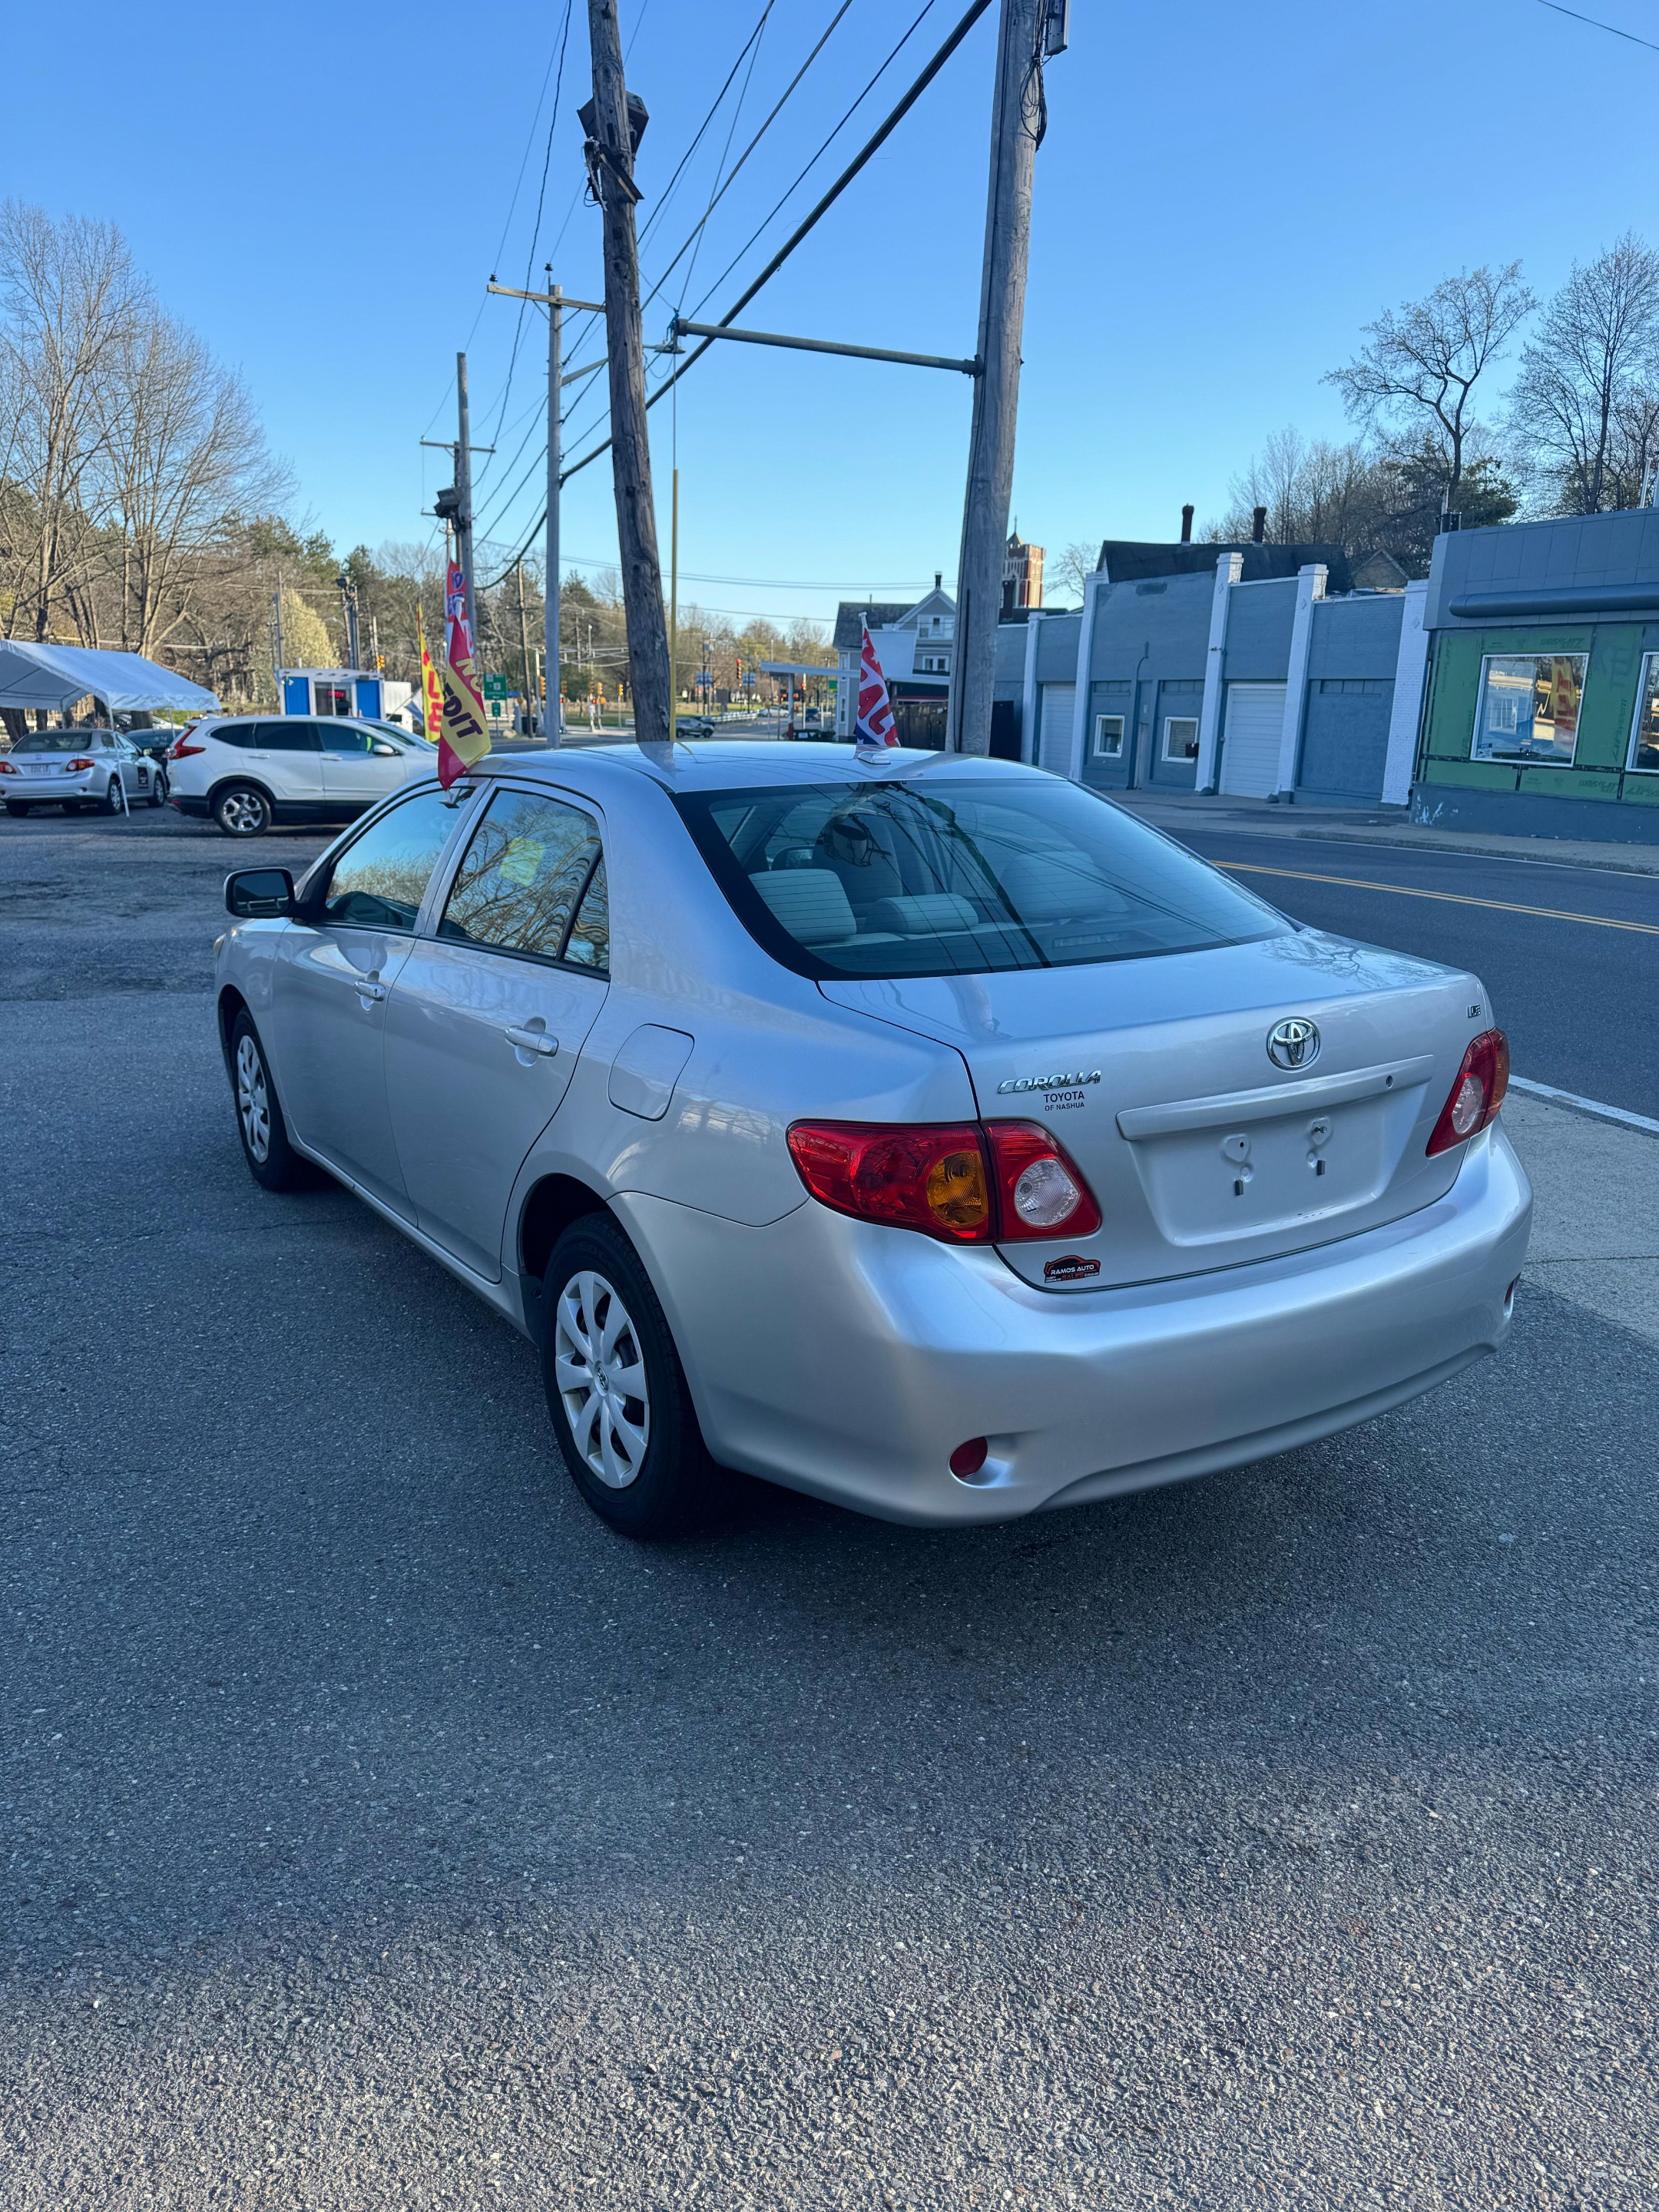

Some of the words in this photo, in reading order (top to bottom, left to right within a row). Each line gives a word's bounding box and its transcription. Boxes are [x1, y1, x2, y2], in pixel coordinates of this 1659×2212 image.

[997, 1070, 1101, 1094] COROLLA
[1043, 1091, 1085, 1103] TOYOTA
[1056, 1102, 1085, 1111] NASHUA
[1051, 1267, 1076, 1276] RAMOS
[1077, 1264, 1094, 1273] AUTO
